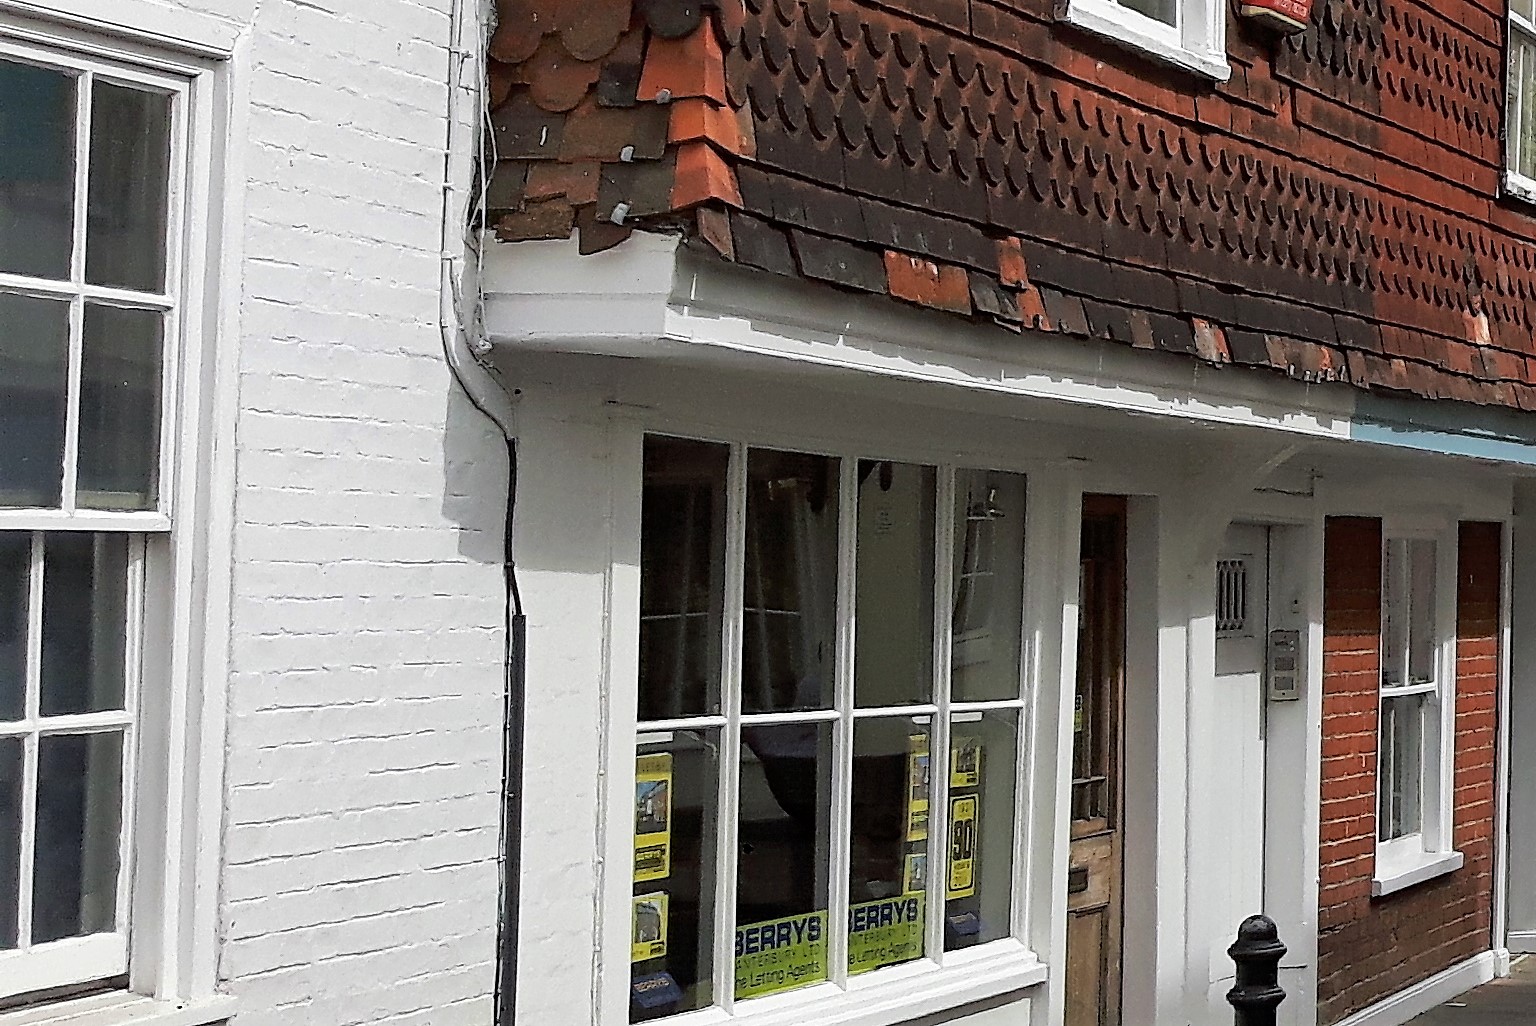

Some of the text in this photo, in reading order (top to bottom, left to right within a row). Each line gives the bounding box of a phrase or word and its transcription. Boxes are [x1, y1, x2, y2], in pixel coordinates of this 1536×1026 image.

[735, 916, 821, 957] BERRYS
[750, 967, 784, 987] Letting
[787, 960, 821, 980] Agents
